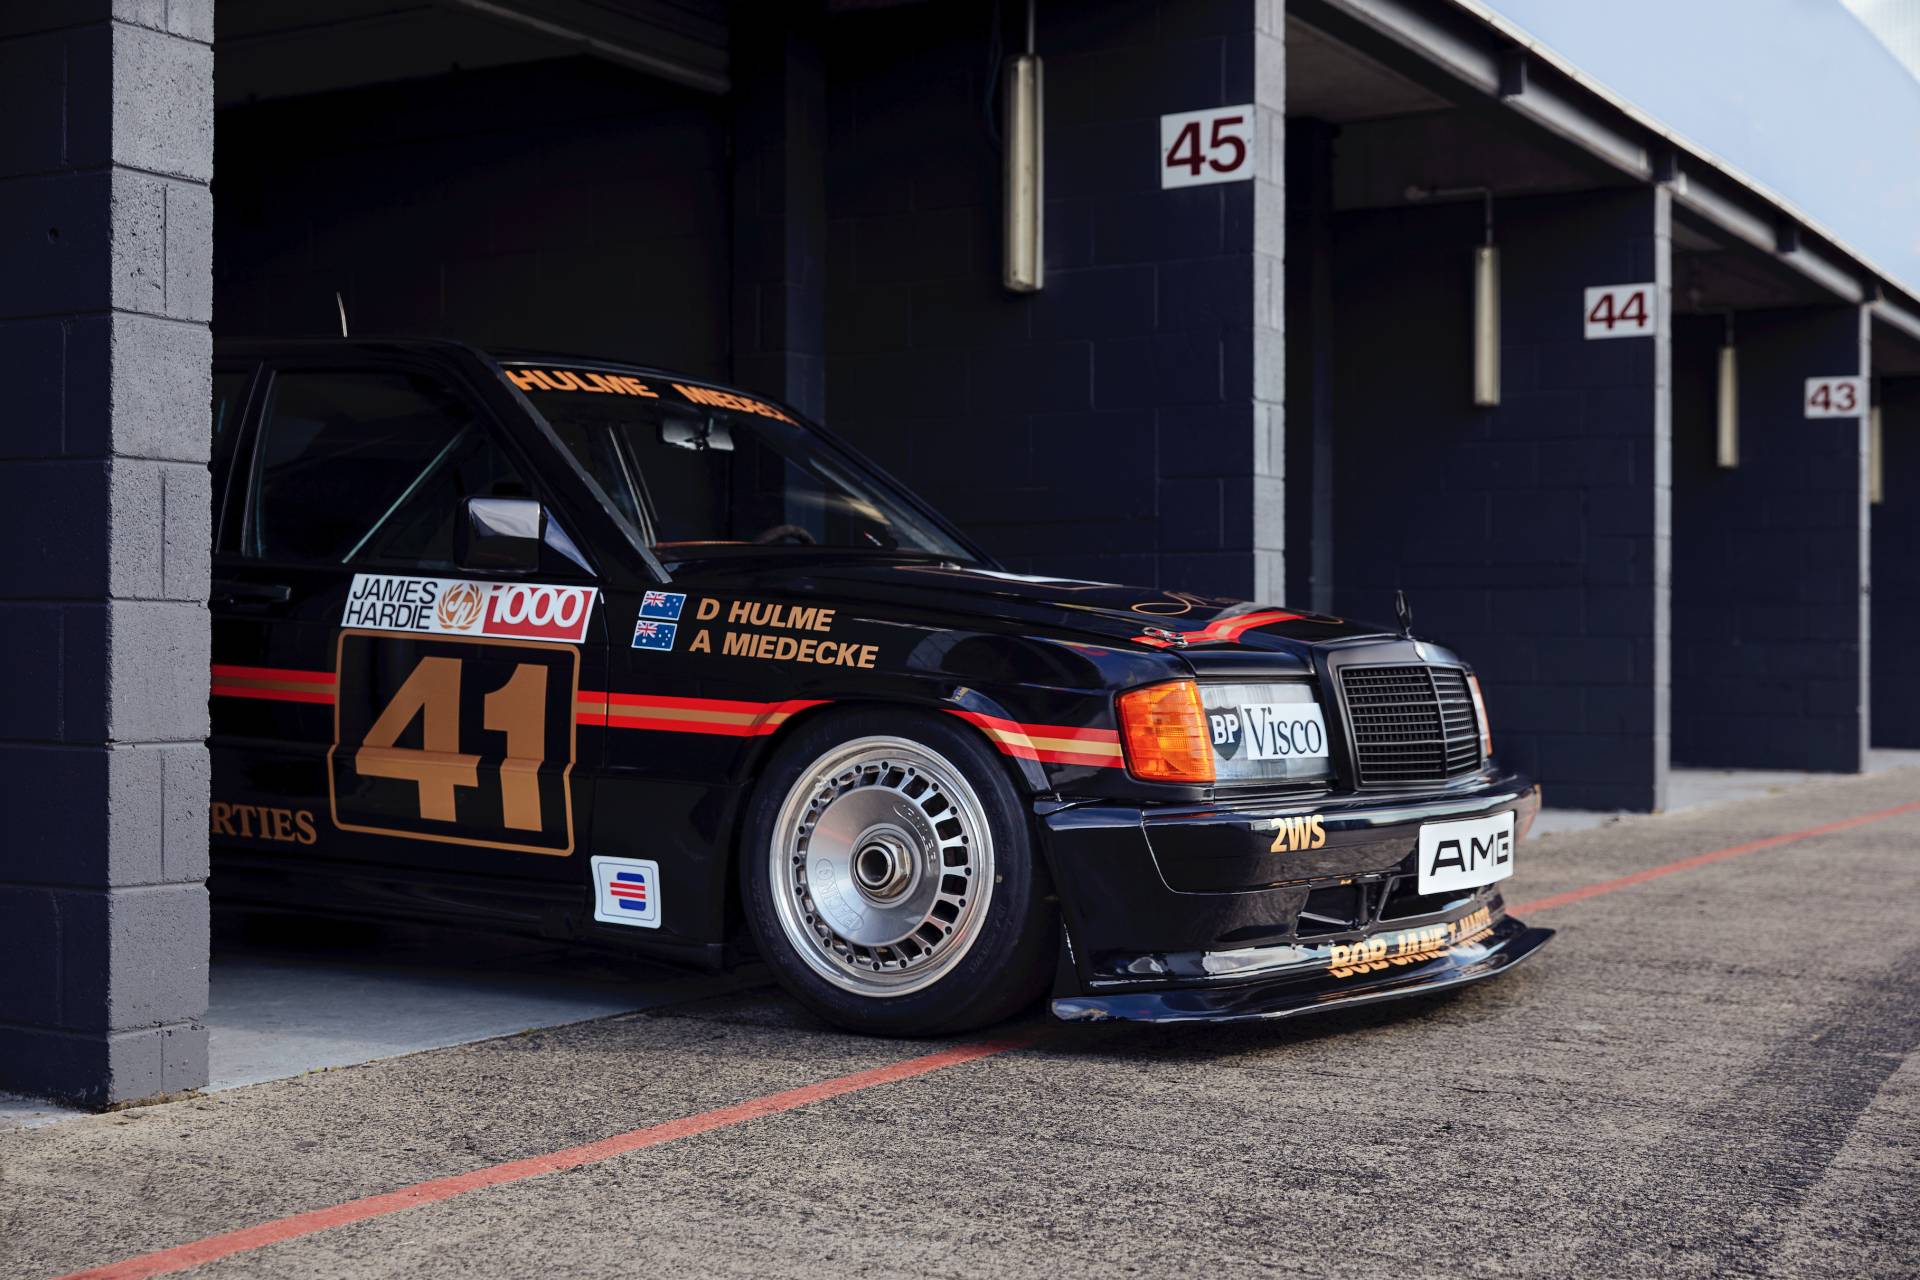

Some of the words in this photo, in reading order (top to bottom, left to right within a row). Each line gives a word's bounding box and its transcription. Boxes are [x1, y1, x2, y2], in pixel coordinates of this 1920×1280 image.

[1167, 116, 1246, 176] 45
[1590, 291, 1649, 329] 44
[505, 369, 660, 399] HULME
[1809, 383, 1857, 411] 43
[352, 577, 438, 605] JAMES
[489, 585, 584, 627] 1000
[345, 602, 434, 630] HARDIE
[696, 598, 720, 620] D
[727, 601, 836, 632] HULME
[689, 629, 711, 653] A
[722, 631, 879, 669] MIEDECKE
[355, 655, 549, 832] 41
[1210, 713, 1239, 745] BP
[1270, 814, 1326, 853] 2WS
[1430, 830, 1509, 877] AMG
